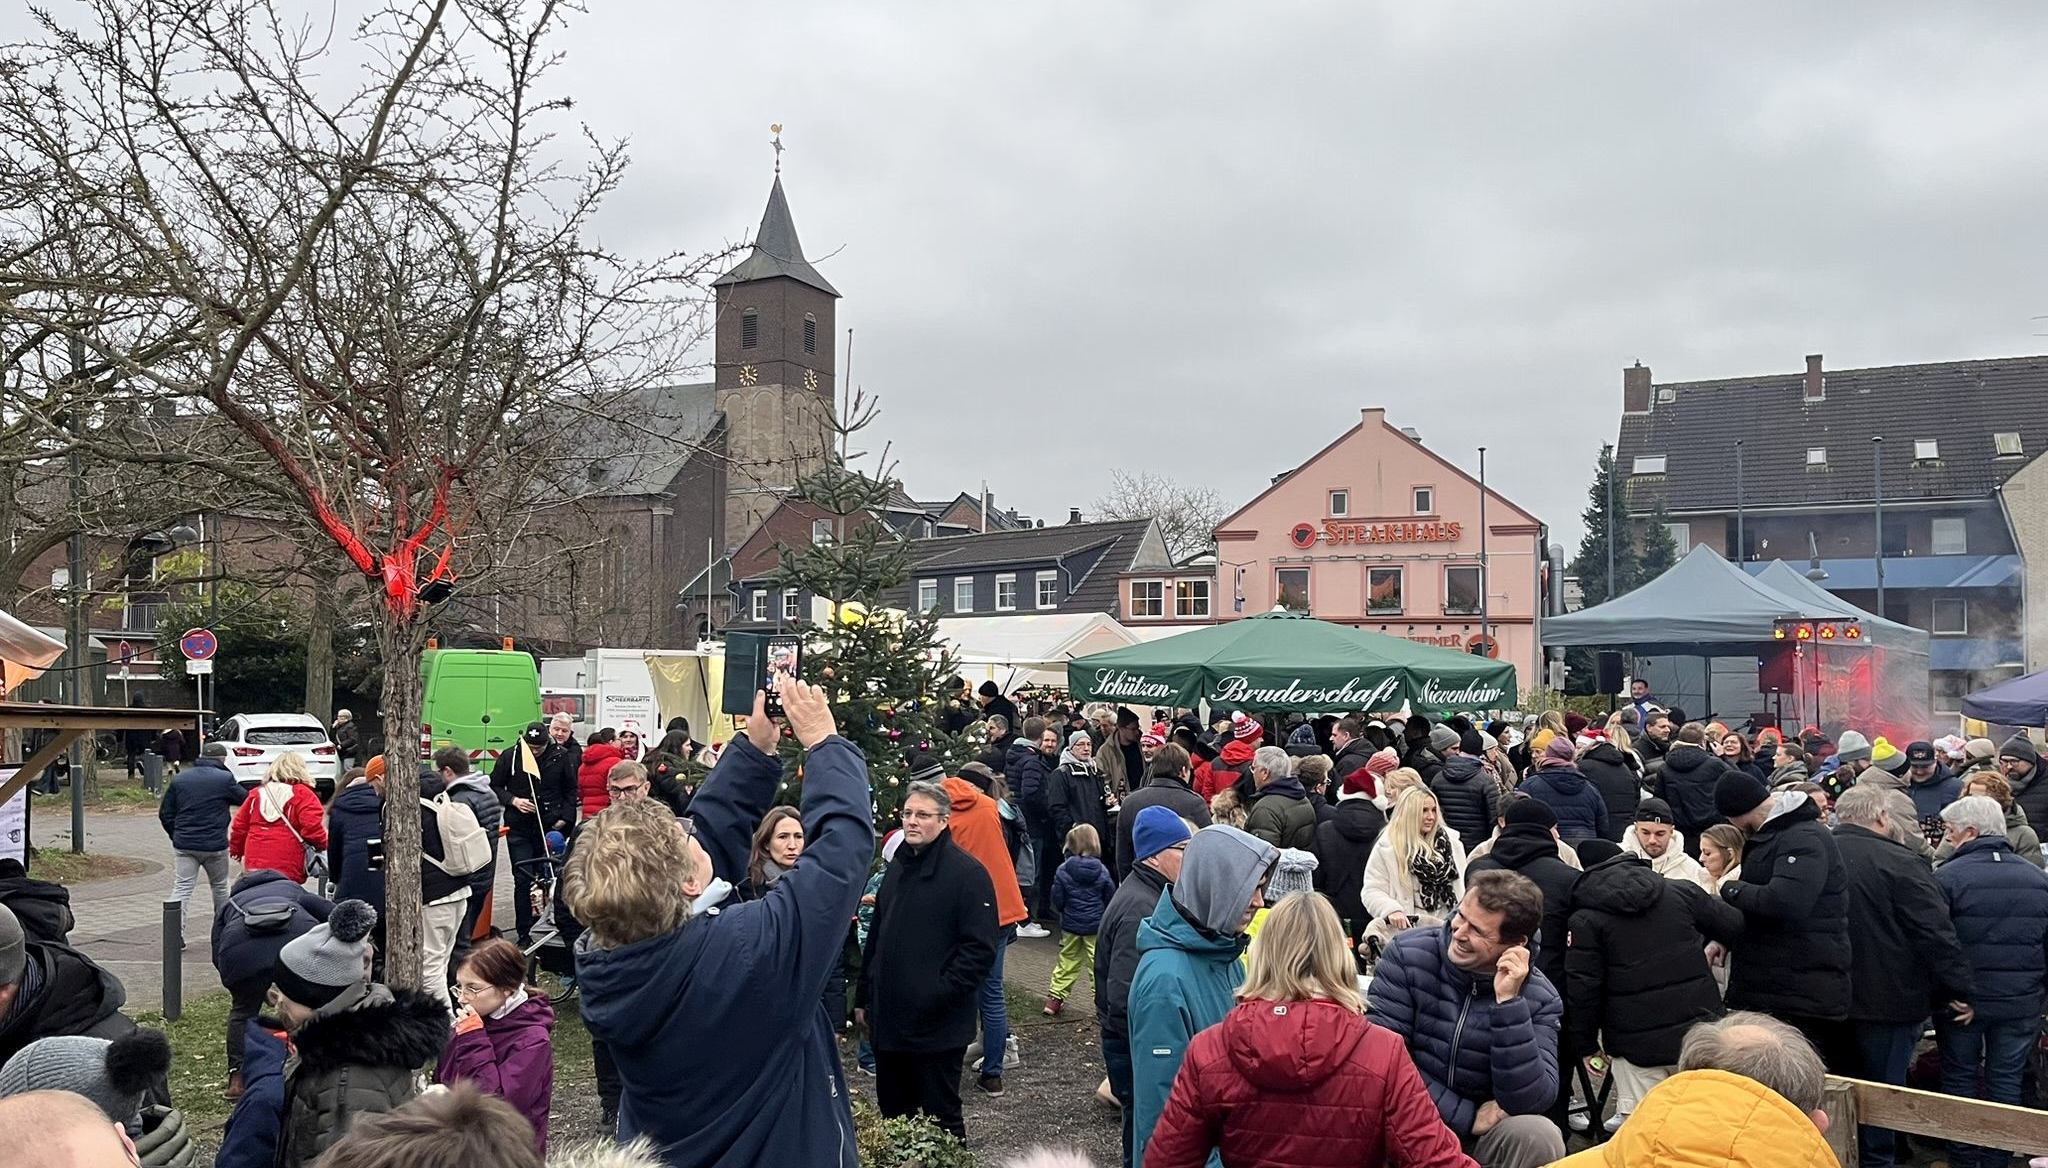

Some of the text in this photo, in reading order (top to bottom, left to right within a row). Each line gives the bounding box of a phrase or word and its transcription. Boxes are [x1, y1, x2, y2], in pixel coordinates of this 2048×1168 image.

[1325, 521, 1462, 546] STEAKHAUS
[1089, 668, 1179, 698] Schützen-
[1210, 675, 1400, 711] Bruderschaft
